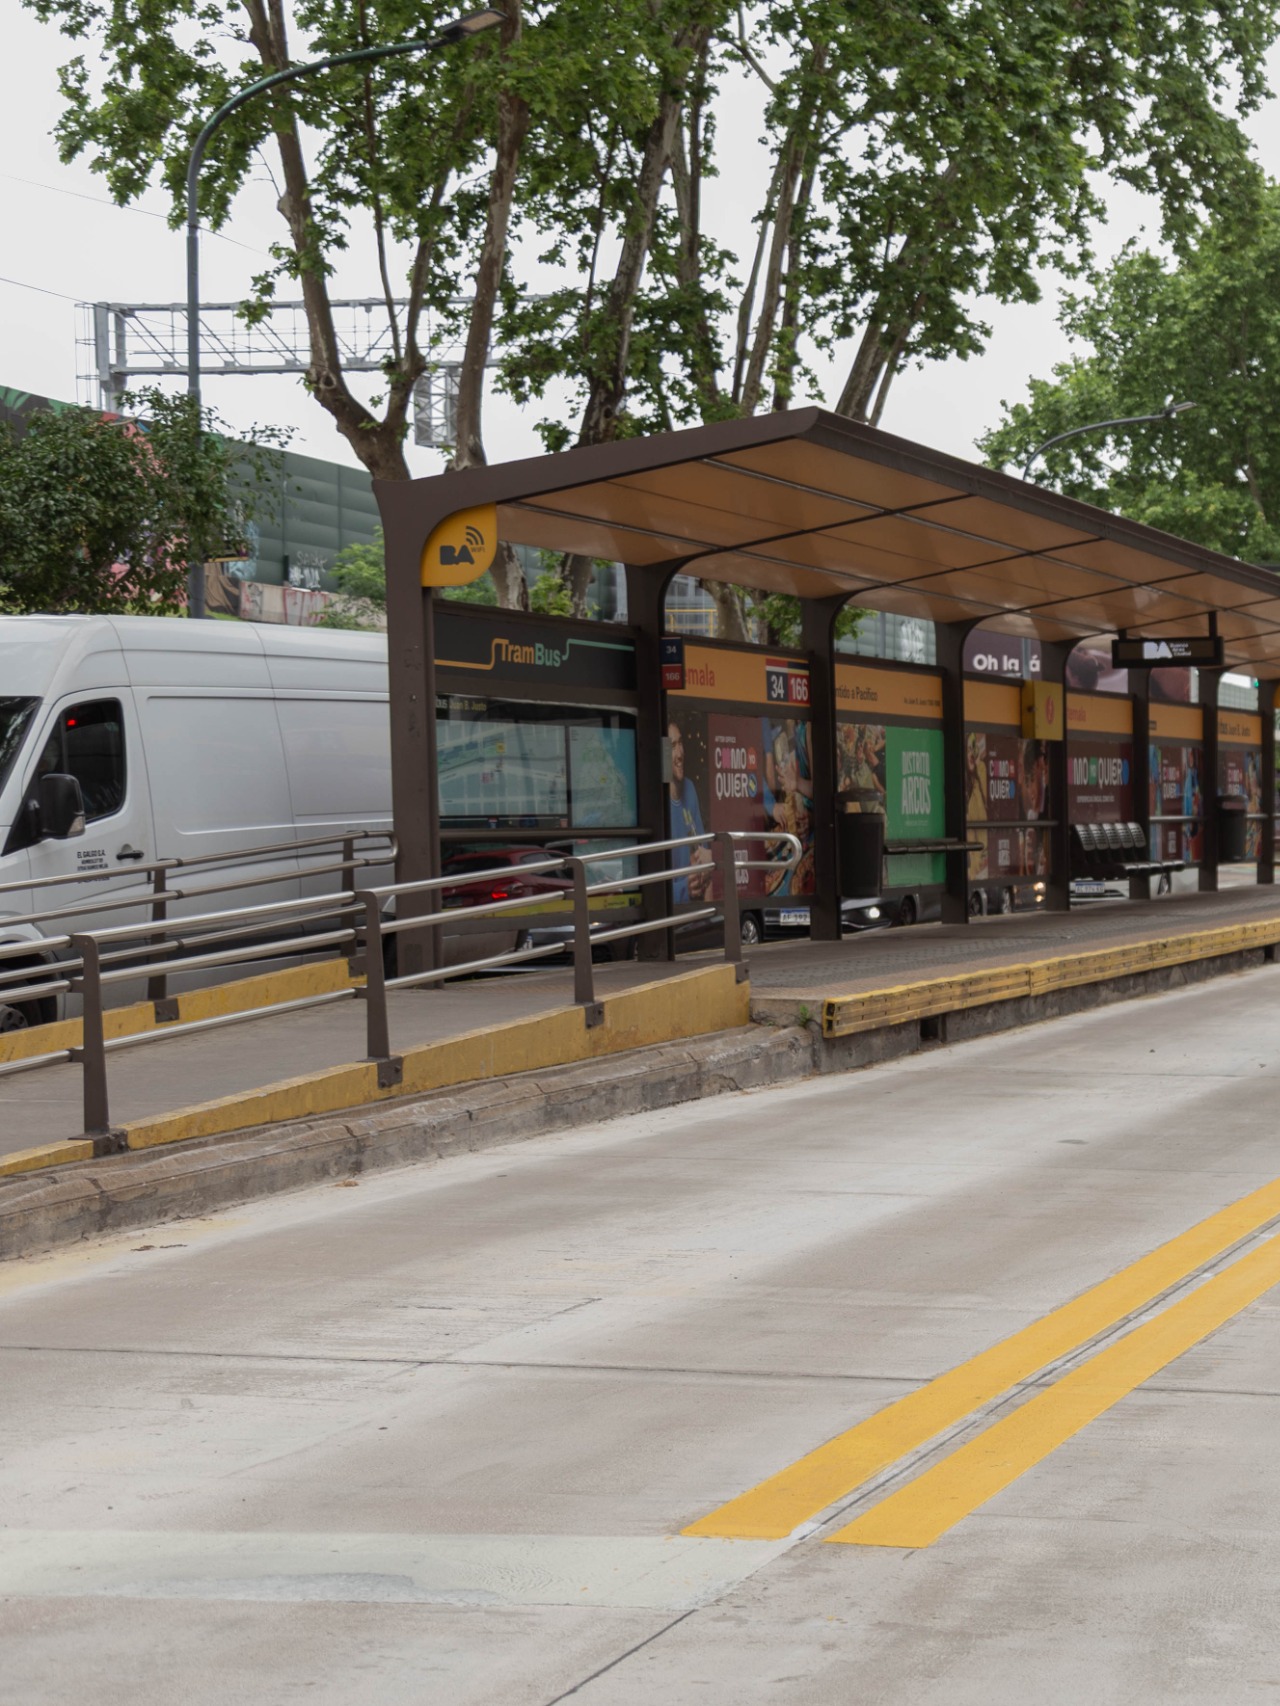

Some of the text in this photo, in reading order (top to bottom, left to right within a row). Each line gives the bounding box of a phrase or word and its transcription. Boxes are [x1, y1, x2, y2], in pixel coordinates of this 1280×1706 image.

[439, 545, 475, 566] BA
[493, 638, 561, 668] TramBus
[665, 645, 677, 654] 34
[1143, 641, 1173, 660] BA
[972, 653, 998, 672] Oh
[665, 672, 681, 682] 166
[770, 674, 809, 701] 34 166
[902, 776, 931, 815] ARCOS
